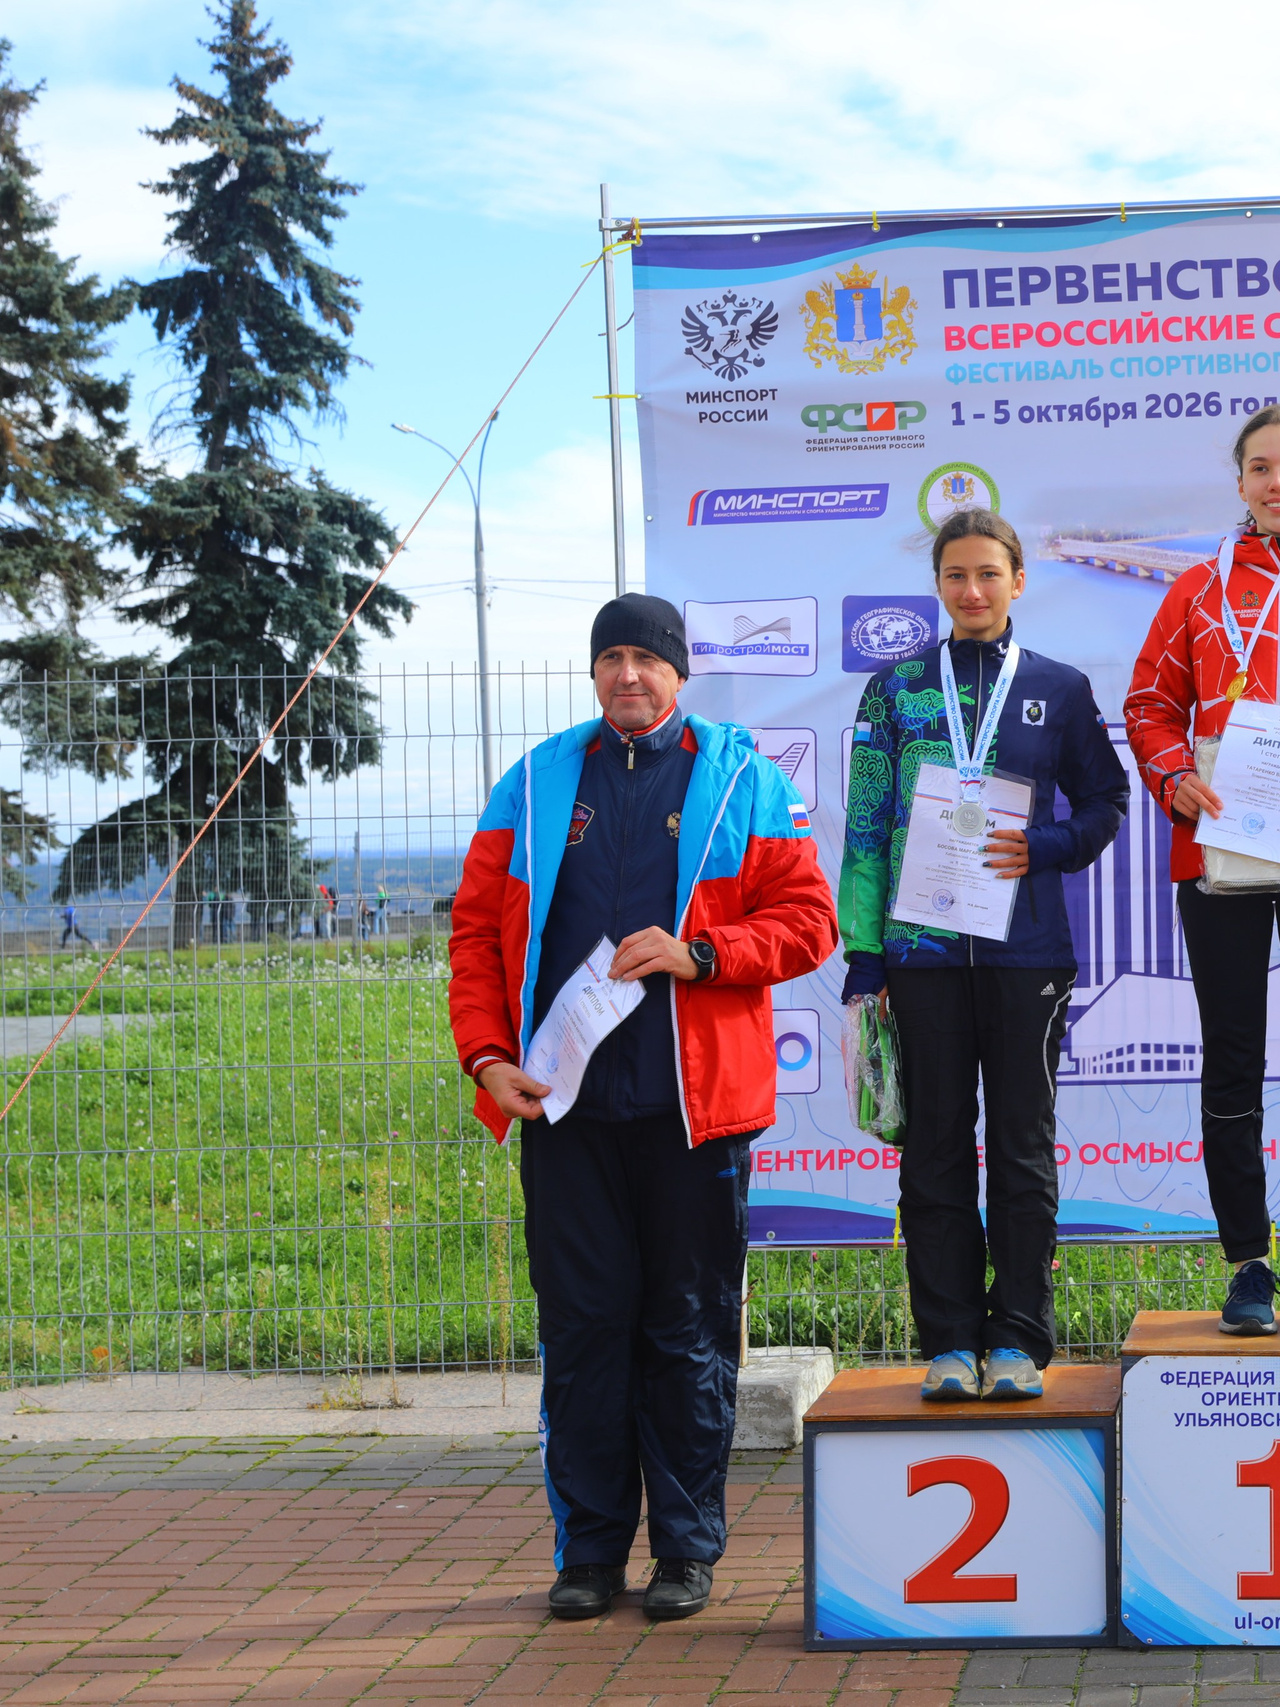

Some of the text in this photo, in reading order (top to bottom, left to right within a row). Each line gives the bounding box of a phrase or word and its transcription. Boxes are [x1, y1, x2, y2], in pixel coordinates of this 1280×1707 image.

[944, 311, 1255, 352] ВСЕРОССИЙСКИЕ
[945, 356, 1104, 385] ФЕСТИВАЛЬ
[686, 388, 778, 405] МИНСПОРТ
[699, 408, 768, 423] РОССИИ
[951, 401, 965, 426] 1
[994, 400, 1010, 425] 5
[1018, 396, 1137, 428] октября
[1145, 391, 1222, 419] 2026
[806, 434, 925, 445] ФЕДЕРАЦИЯ СПОРТИВНОГО
[806, 442, 925, 453] ОРИЕНТИРОВАНИЯ РОССИИ
[714, 490, 880, 511] МИНСПОРТ
[1160, 1371, 1275, 1388] ФЕДЕРАЦИЯ
[903, 1455, 1018, 1604] 2
